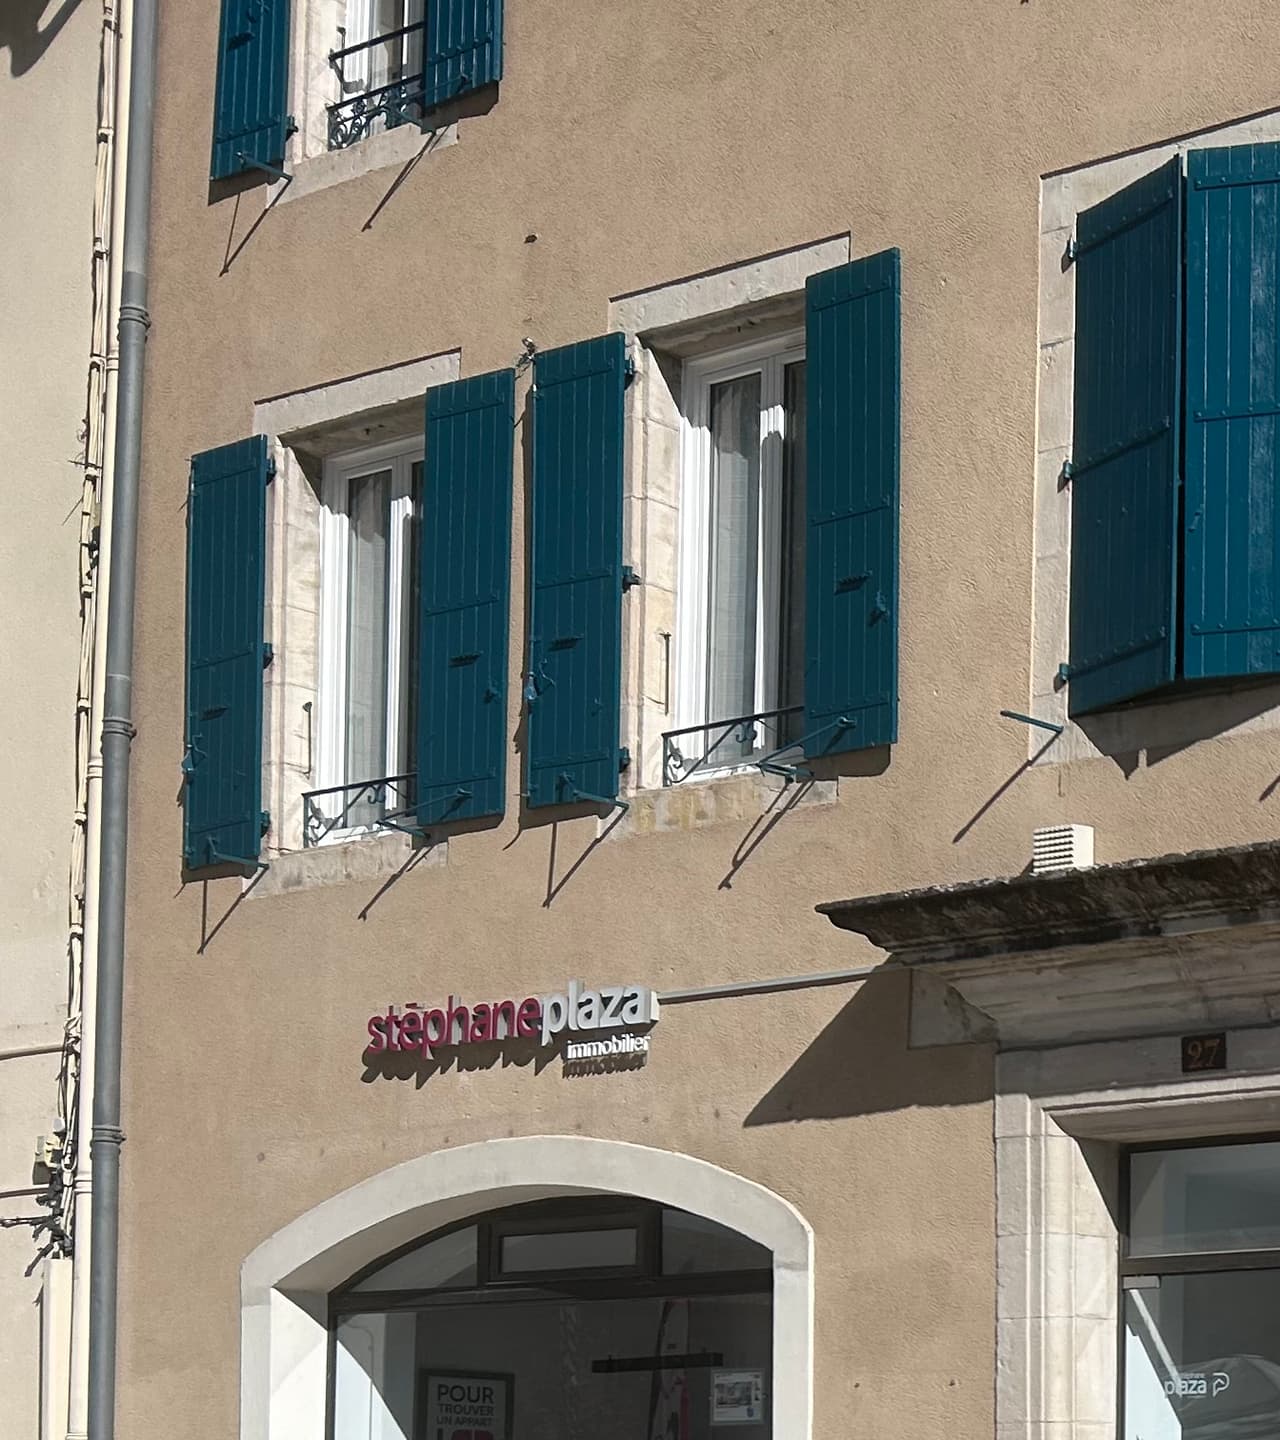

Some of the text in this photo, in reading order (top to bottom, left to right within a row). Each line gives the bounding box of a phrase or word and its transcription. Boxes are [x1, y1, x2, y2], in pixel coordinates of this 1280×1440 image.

[566, 1033, 652, 1061] immobilier
[1187, 1039, 1220, 1068] 27
[437, 1383, 494, 1404] POUR
[1164, 1376, 1207, 1398] paza
[439, 1403, 494, 1416] TROUVER
[436, 1415, 494, 1427] UN APPART
